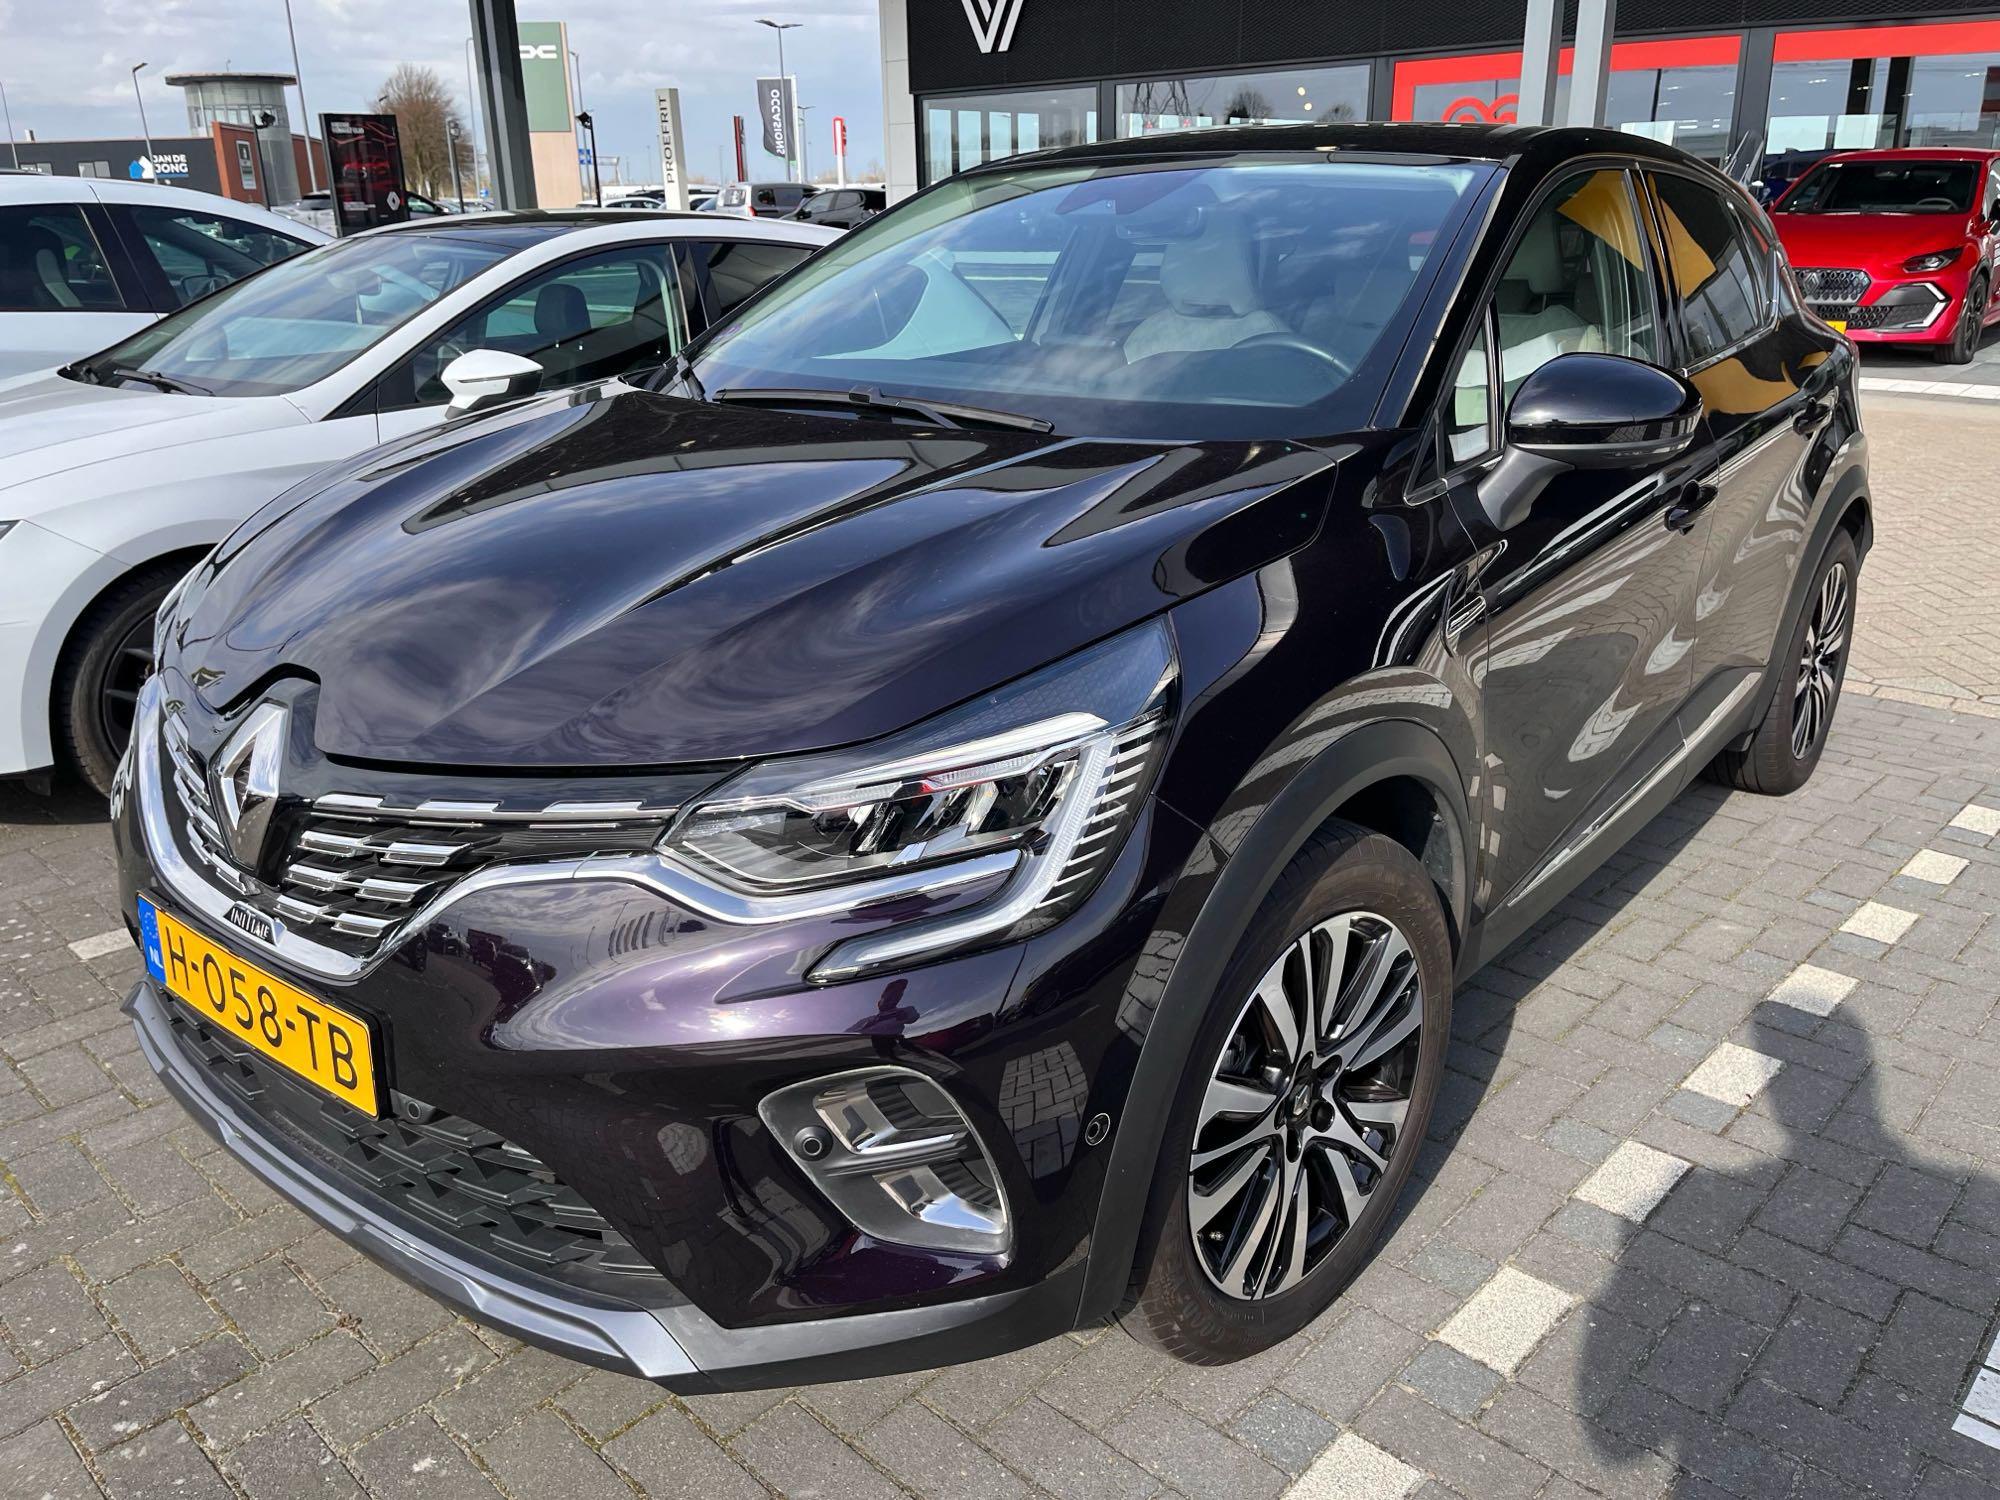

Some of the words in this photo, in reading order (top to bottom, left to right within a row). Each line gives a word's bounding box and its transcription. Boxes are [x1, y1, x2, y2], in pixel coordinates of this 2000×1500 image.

[658, 95, 675, 184] PROEFRIT
[152, 155, 171, 163] JAN
[172, 154, 187, 163] DE
[154, 163, 188, 174] JONG
[230, 907, 270, 940] INITIALE
[149, 944, 164, 969] NL
[165, 925, 358, 1091] H-058-TB
